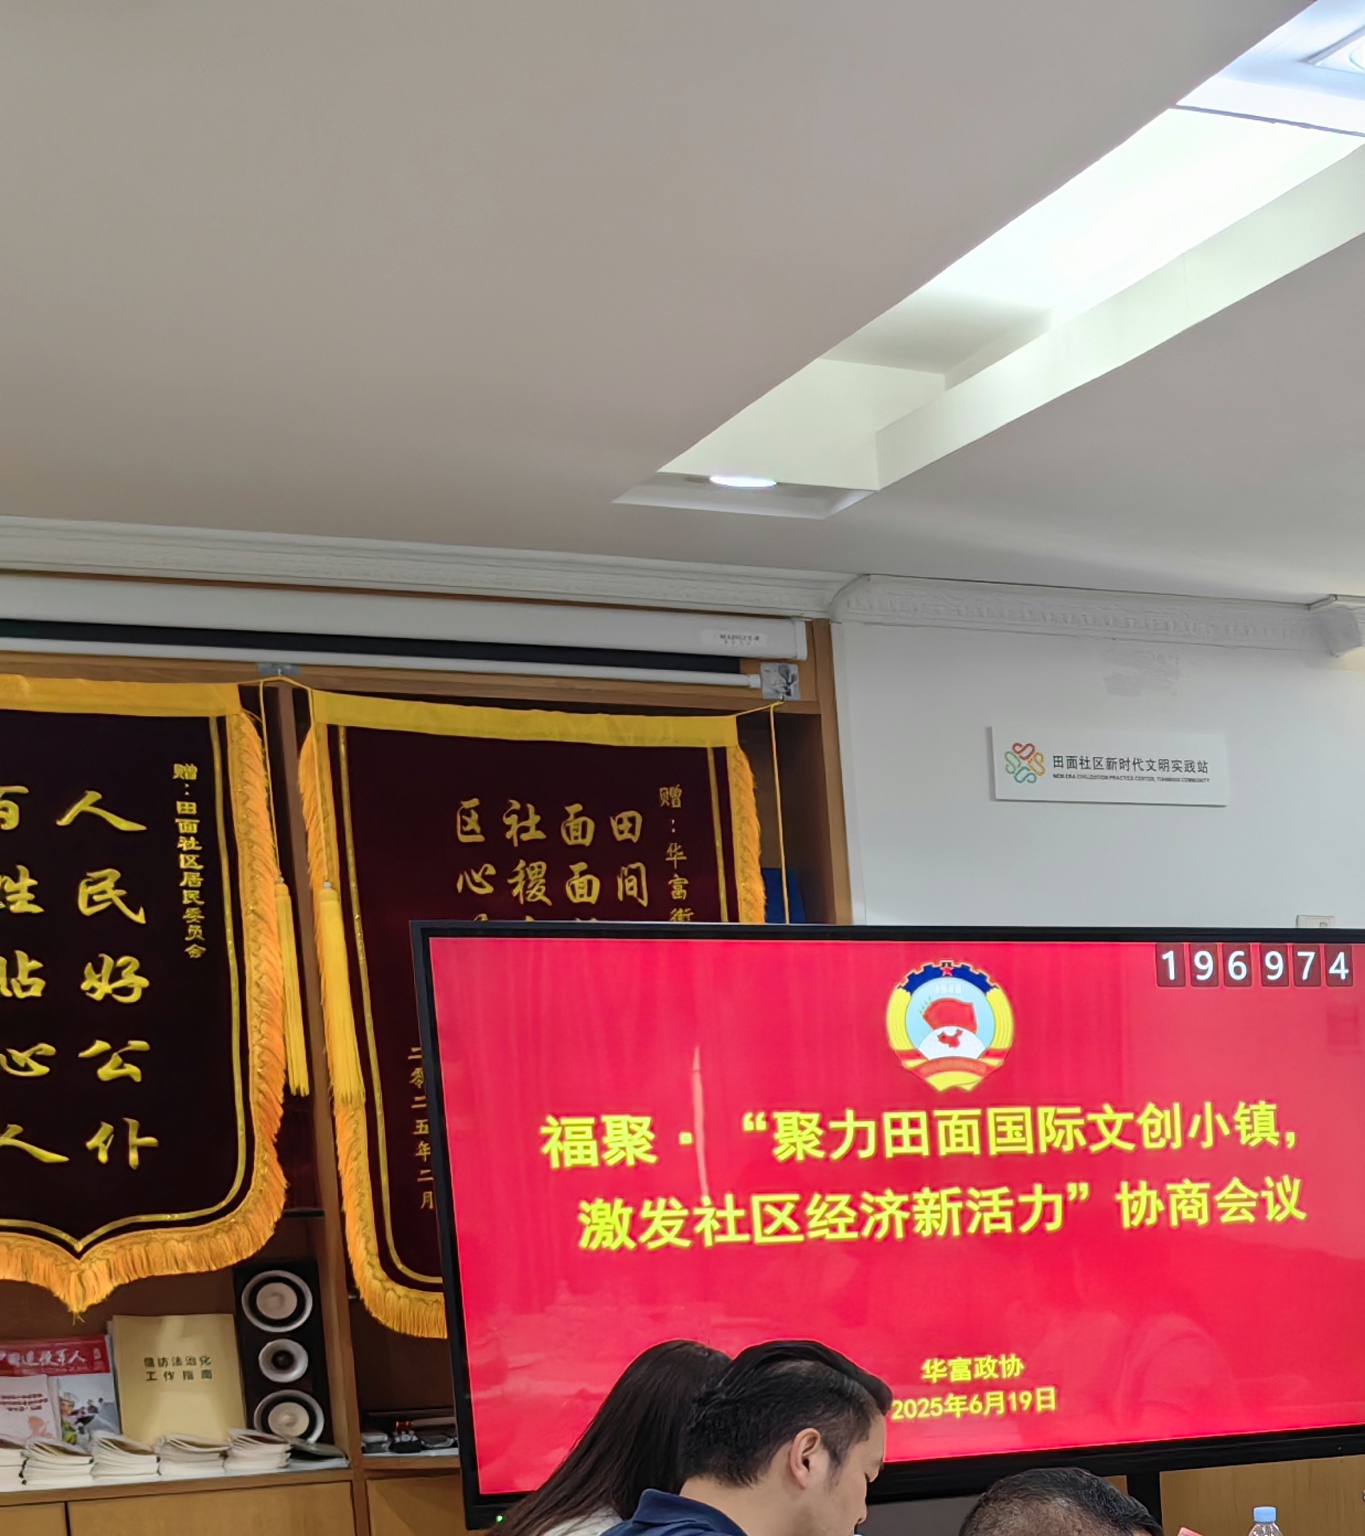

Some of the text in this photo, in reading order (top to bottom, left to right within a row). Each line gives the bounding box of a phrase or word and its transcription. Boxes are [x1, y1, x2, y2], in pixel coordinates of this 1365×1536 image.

[1052, 755, 1209, 774] 田面社区新时代文明实践站
[56, 790, 159, 1169] 人民好公仆
[921, 1354, 1025, 1383] 华富政协
[891, 1386, 1056, 1420] 2025年6月19日
